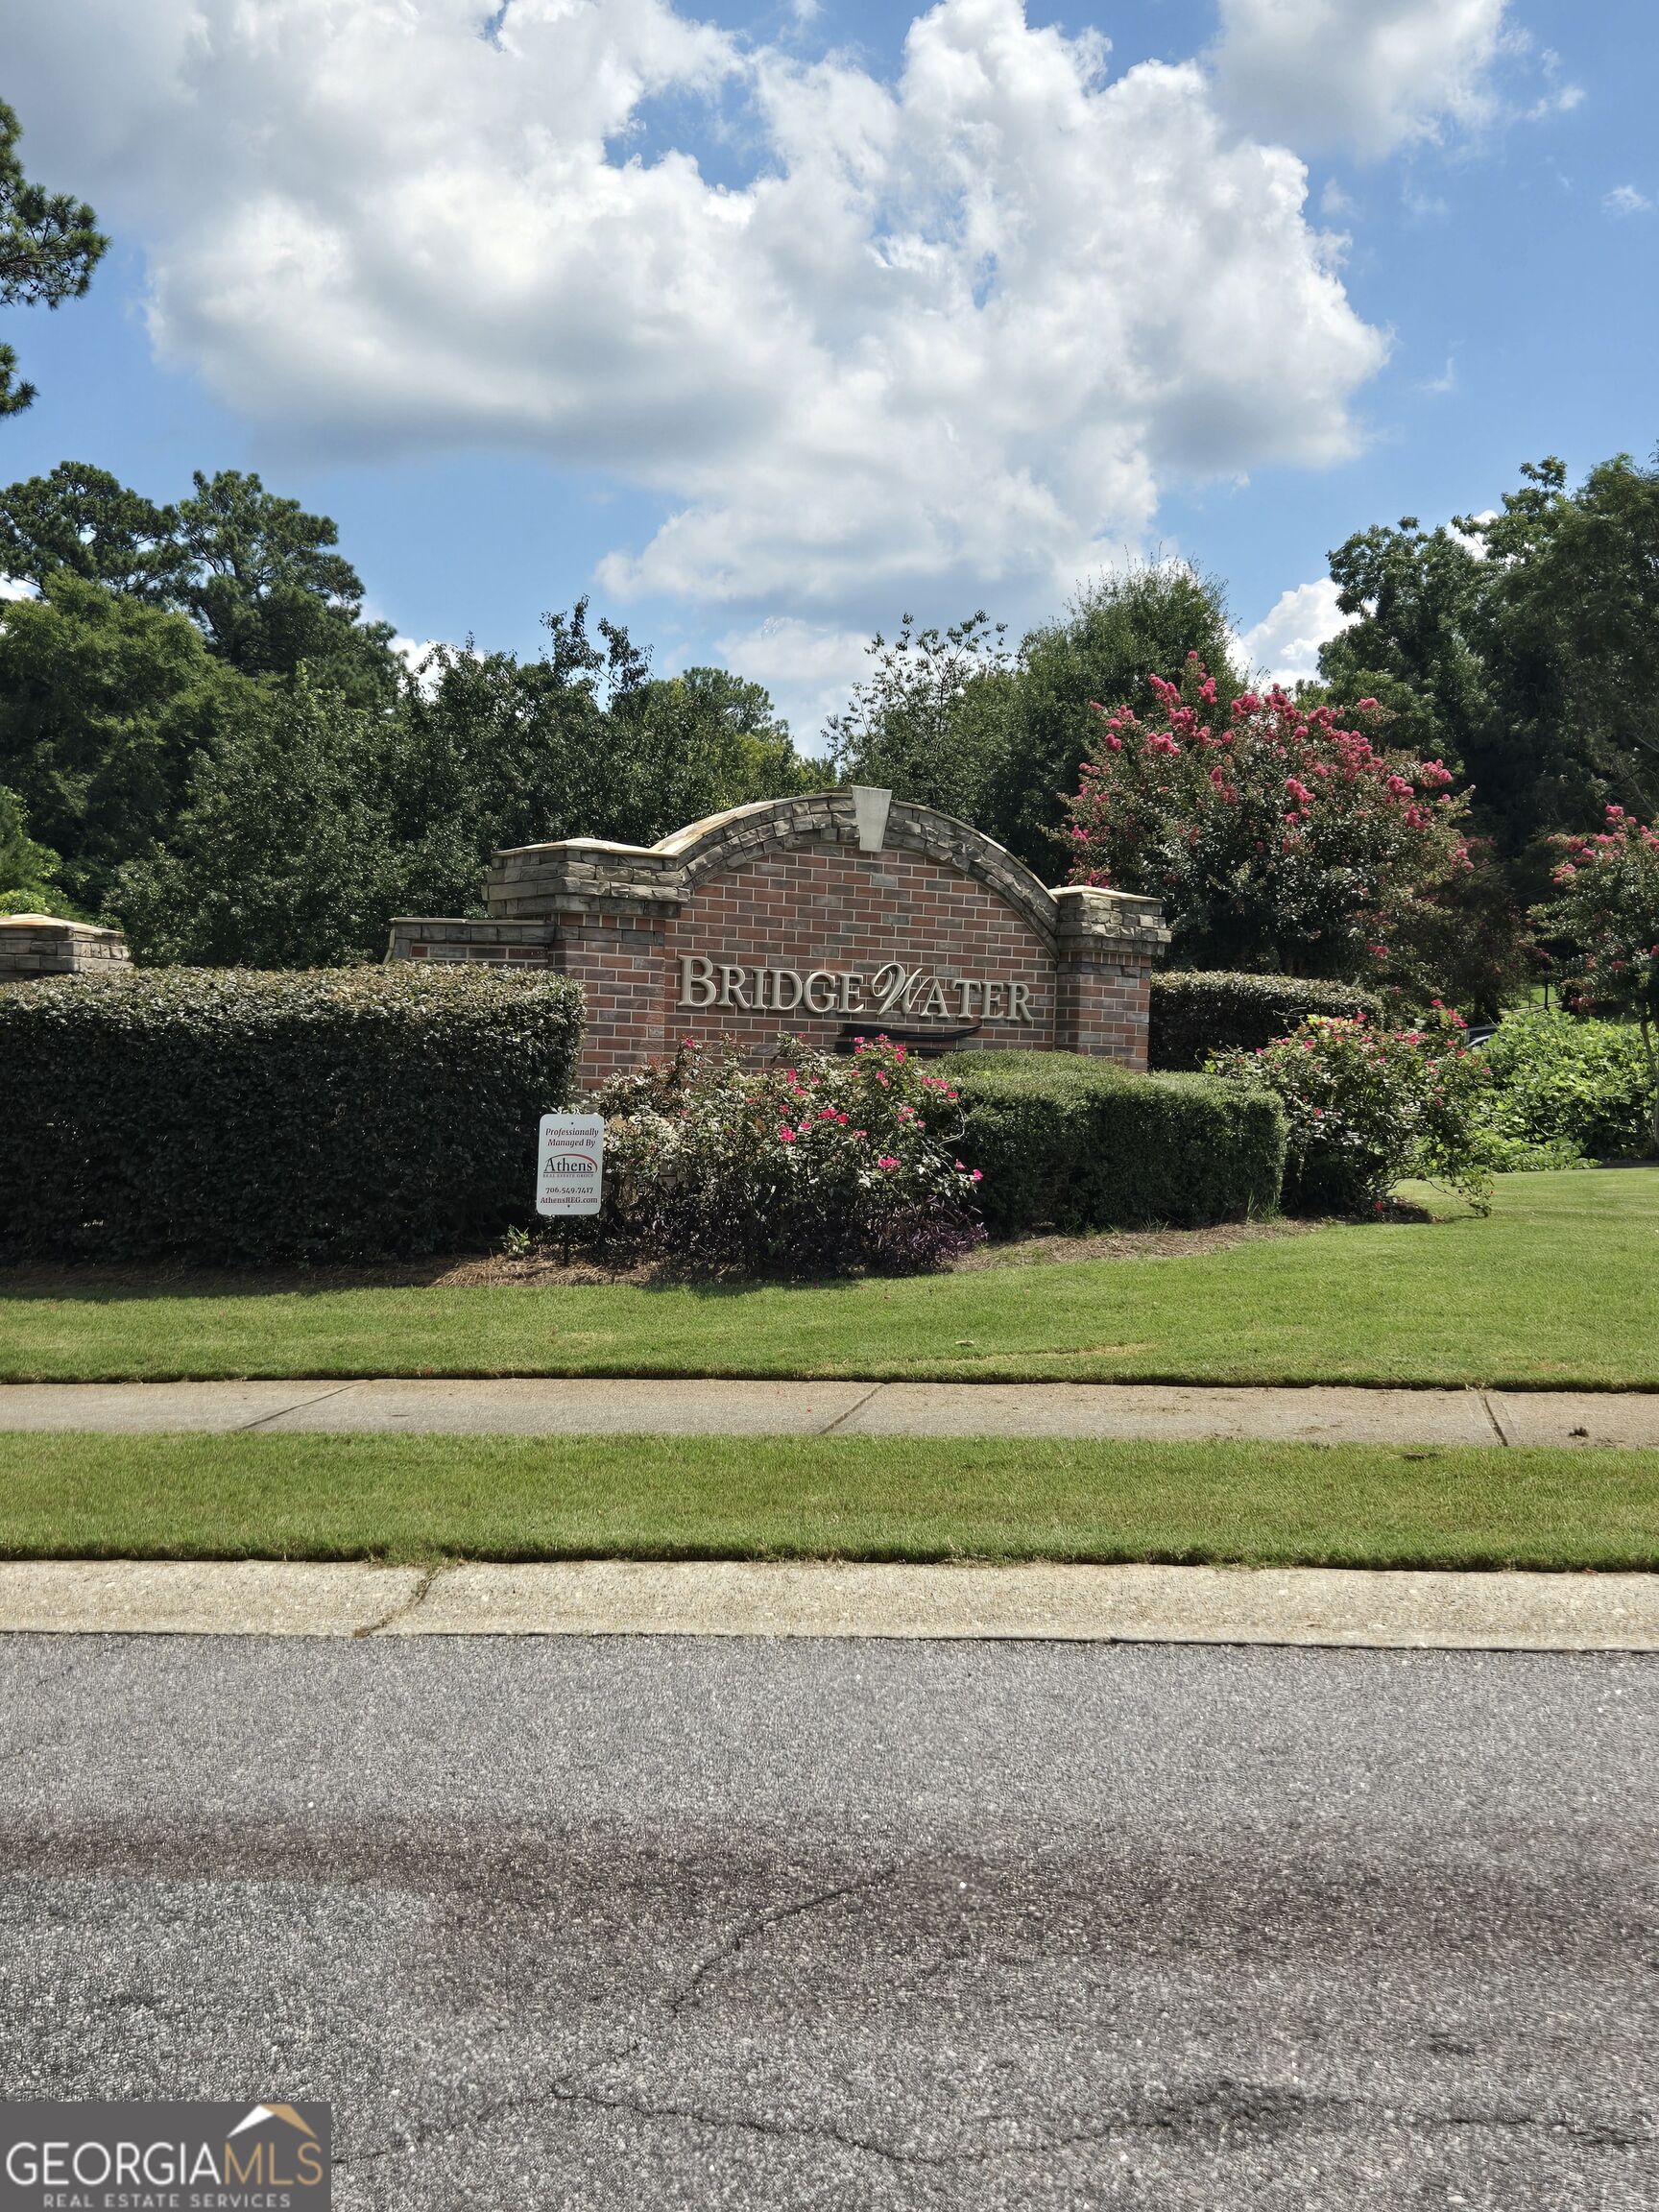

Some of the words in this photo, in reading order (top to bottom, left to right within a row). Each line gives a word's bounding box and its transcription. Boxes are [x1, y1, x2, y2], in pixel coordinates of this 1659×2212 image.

[545, 1128, 599, 1138] Professionally
[547, 1139, 584, 1148] Managed
[586, 1139, 596, 1148] By
[543, 1157, 593, 1172] Athens
